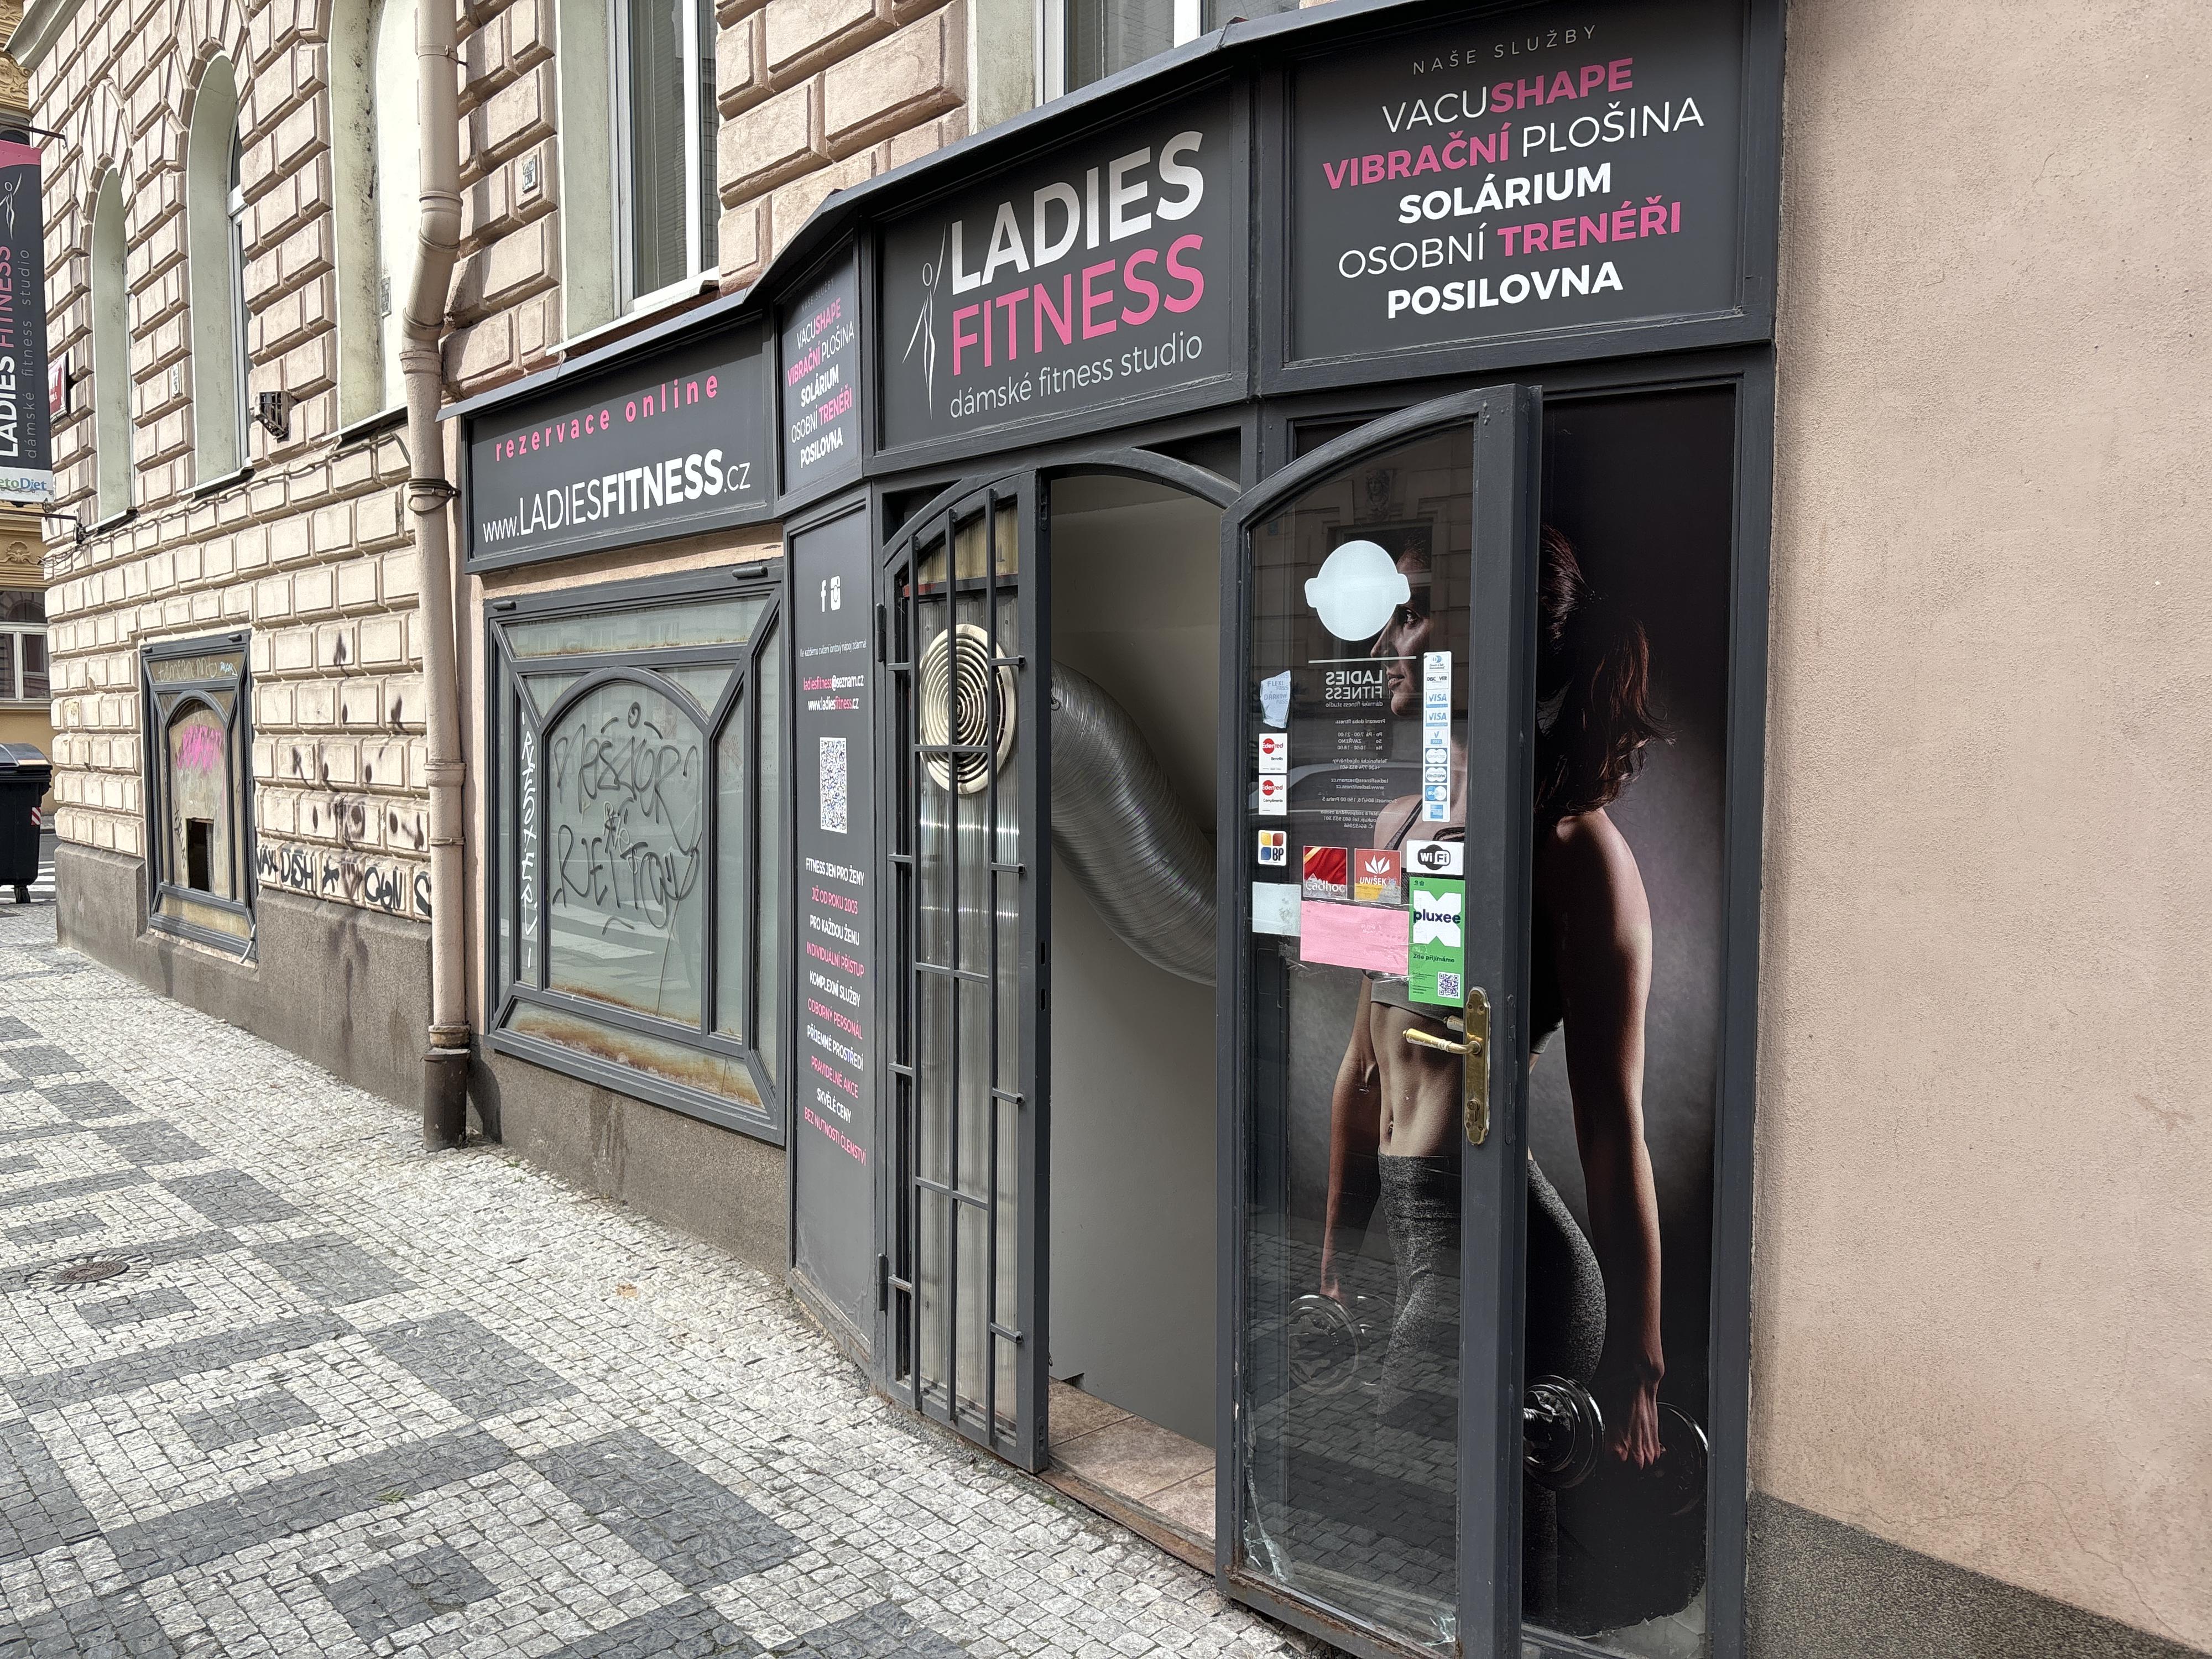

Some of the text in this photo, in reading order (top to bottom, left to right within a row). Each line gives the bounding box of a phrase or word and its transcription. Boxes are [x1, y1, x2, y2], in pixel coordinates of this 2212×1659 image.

[1413, 24, 1597, 76] NAŠE SLUŽBY
[1381, 58, 1634, 134] VACUSHAPE
[1323, 97, 1705, 190] VIBRAČNÍ PLOŠINA
[951, 131, 1204, 296] LADIES
[1398, 162, 1611, 225] SOLÁRIUM
[1338, 195, 1681, 279] OSOBNÍ TRENÉŘI
[953, 234, 1204, 377] FITNESS
[1387, 261, 1624, 319] POSILOVNA
[796, 296, 842, 350] VACUSHAPE
[17, 249, 37, 459] dámské fitness studio
[787, 320, 855, 387] VIBRAČNÍ PLOŠINA
[950, 332, 1203, 419] dámské fitness studio
[0, 356, 19, 458] LADIES
[801, 363, 839, 408] SOLÁRIUM
[495, 374, 718, 462] rezervace online
[791, 383, 853, 444] OSOBNÍ TRENÉŘI
[800, 427, 843, 468] POSILOVNA
[0, 477, 47, 492] etoDiet
[842, 640, 852, 653] nápoj
[803, 675, 864, 691] ladiesfitness@seznam.cz
[807, 696, 859, 711] www.ladiesfitness.cz
[1429, 693, 1447, 702] VISA
[1429, 712, 1447, 721] VISA
[806, 857, 865, 886] FITNESS JEN PRO ŽENY
[1272, 847, 1284, 861] BP
[811, 885, 858, 915] JIŽ OD ROKU 2003
[1359, 875, 1387, 886] UNIŠEK
[810, 914, 860, 946] PRO KAŽDOU ŽENU
[1413, 908, 1461, 924] pluxee
[806, 941, 865, 978] INDIVIDUÁLNÍ PŘÍSTUP
[1425, 954, 1455, 963] přijímáme
[810, 970, 861, 1008] KOMPLEXNÍ SLUŽBY
[807, 998, 863, 1040] ODBORNÝ PERSONÁL
[807, 1022, 864, 1071] PŘÍJEMNÉ PROSTŘEDÍ
[811, 1055, 859, 1099] PRAVIDELNÉ AKCE
[817, 1087, 852, 1124] SKVĚLÉ CENY
[805, 1106, 867, 1167] BEZ NUTNOSTI ČLENSTVÍ
